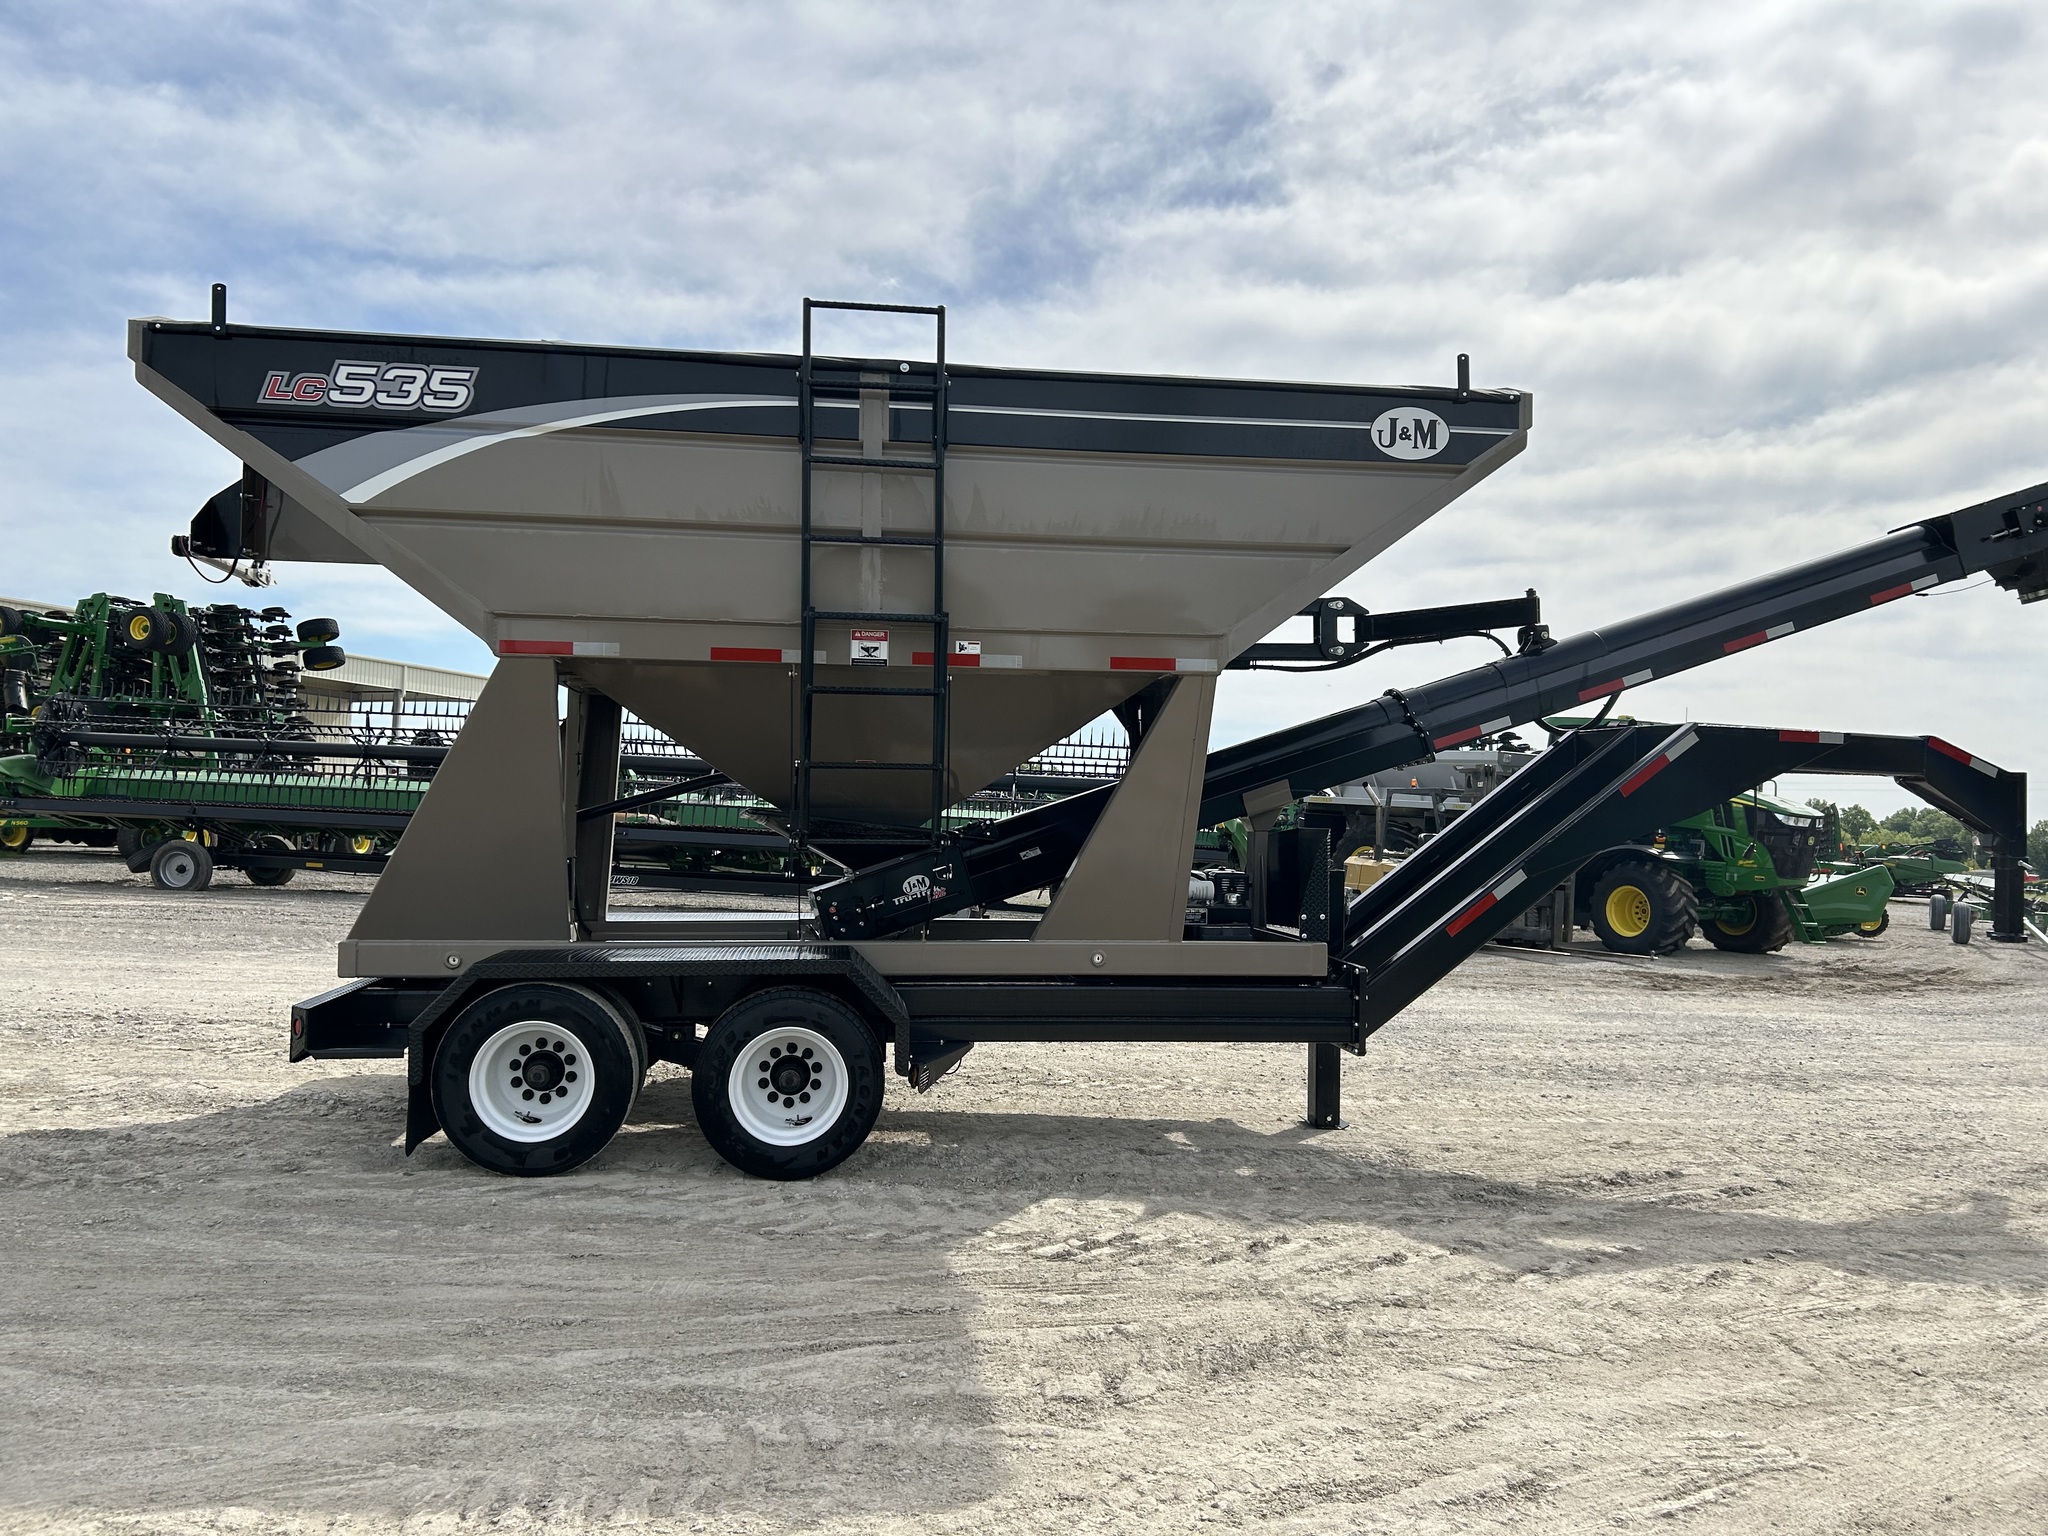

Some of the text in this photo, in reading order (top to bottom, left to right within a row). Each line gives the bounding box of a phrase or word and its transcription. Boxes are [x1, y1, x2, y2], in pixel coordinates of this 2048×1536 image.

[261, 361, 476, 411] LC535
[1376, 417, 1439, 450] J&M
[904, 877, 927, 893] J&M
[446, 999, 541, 1079] IRONMAN
[817, 1053, 871, 1162] IRONMAN
